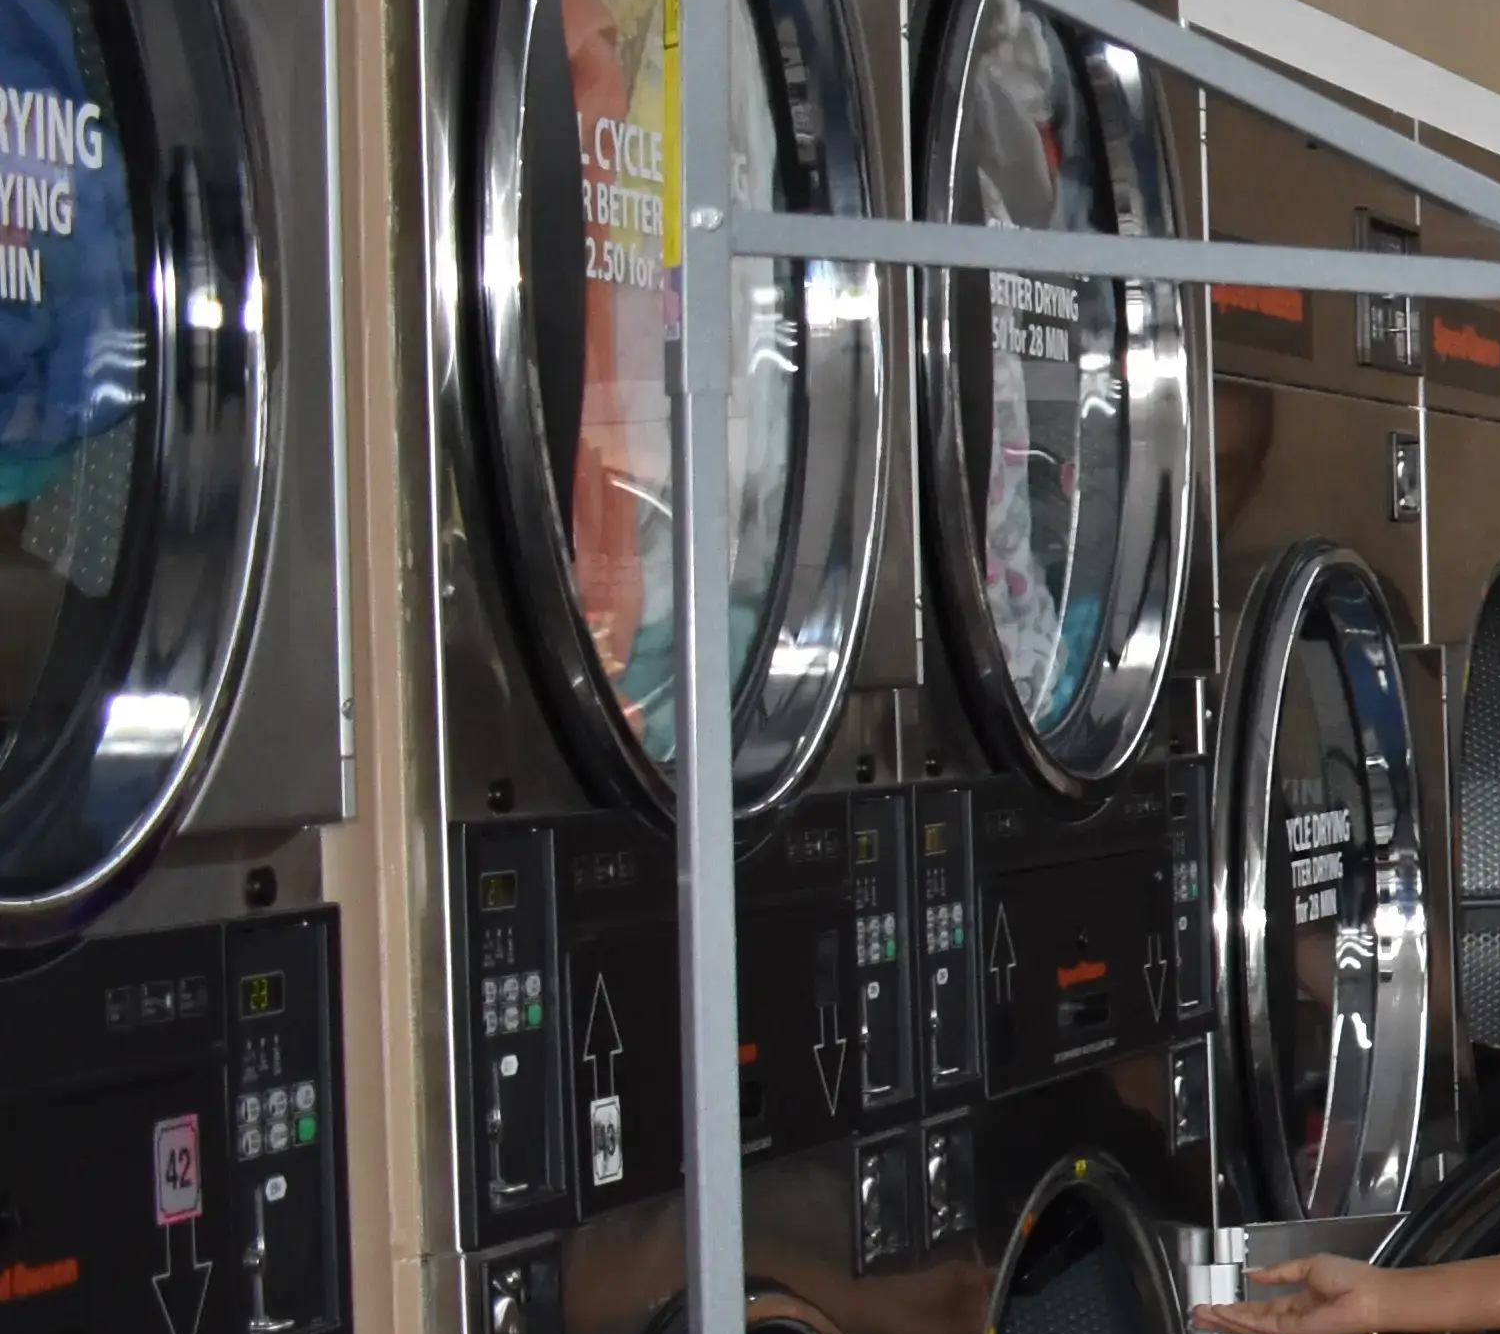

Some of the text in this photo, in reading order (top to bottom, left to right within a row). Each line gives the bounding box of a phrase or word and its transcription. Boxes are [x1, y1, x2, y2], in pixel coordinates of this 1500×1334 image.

[0, 85, 102, 169] YING
[595, 116, 663, 183] CYCLE
[0, 172, 73, 235] YING
[597, 181, 664, 236] BETTER
[627, 242, 655, 288] for
[1034, 280, 1079, 322] DRYING
[1009, 317, 1027, 354] for
[1028, 323, 1045, 358] 28
[1045, 326, 1069, 363] MIN
[1286, 816, 1313, 852] YCLE
[1291, 857, 1313, 889] TTER
[164, 1146, 193, 1191] 42
